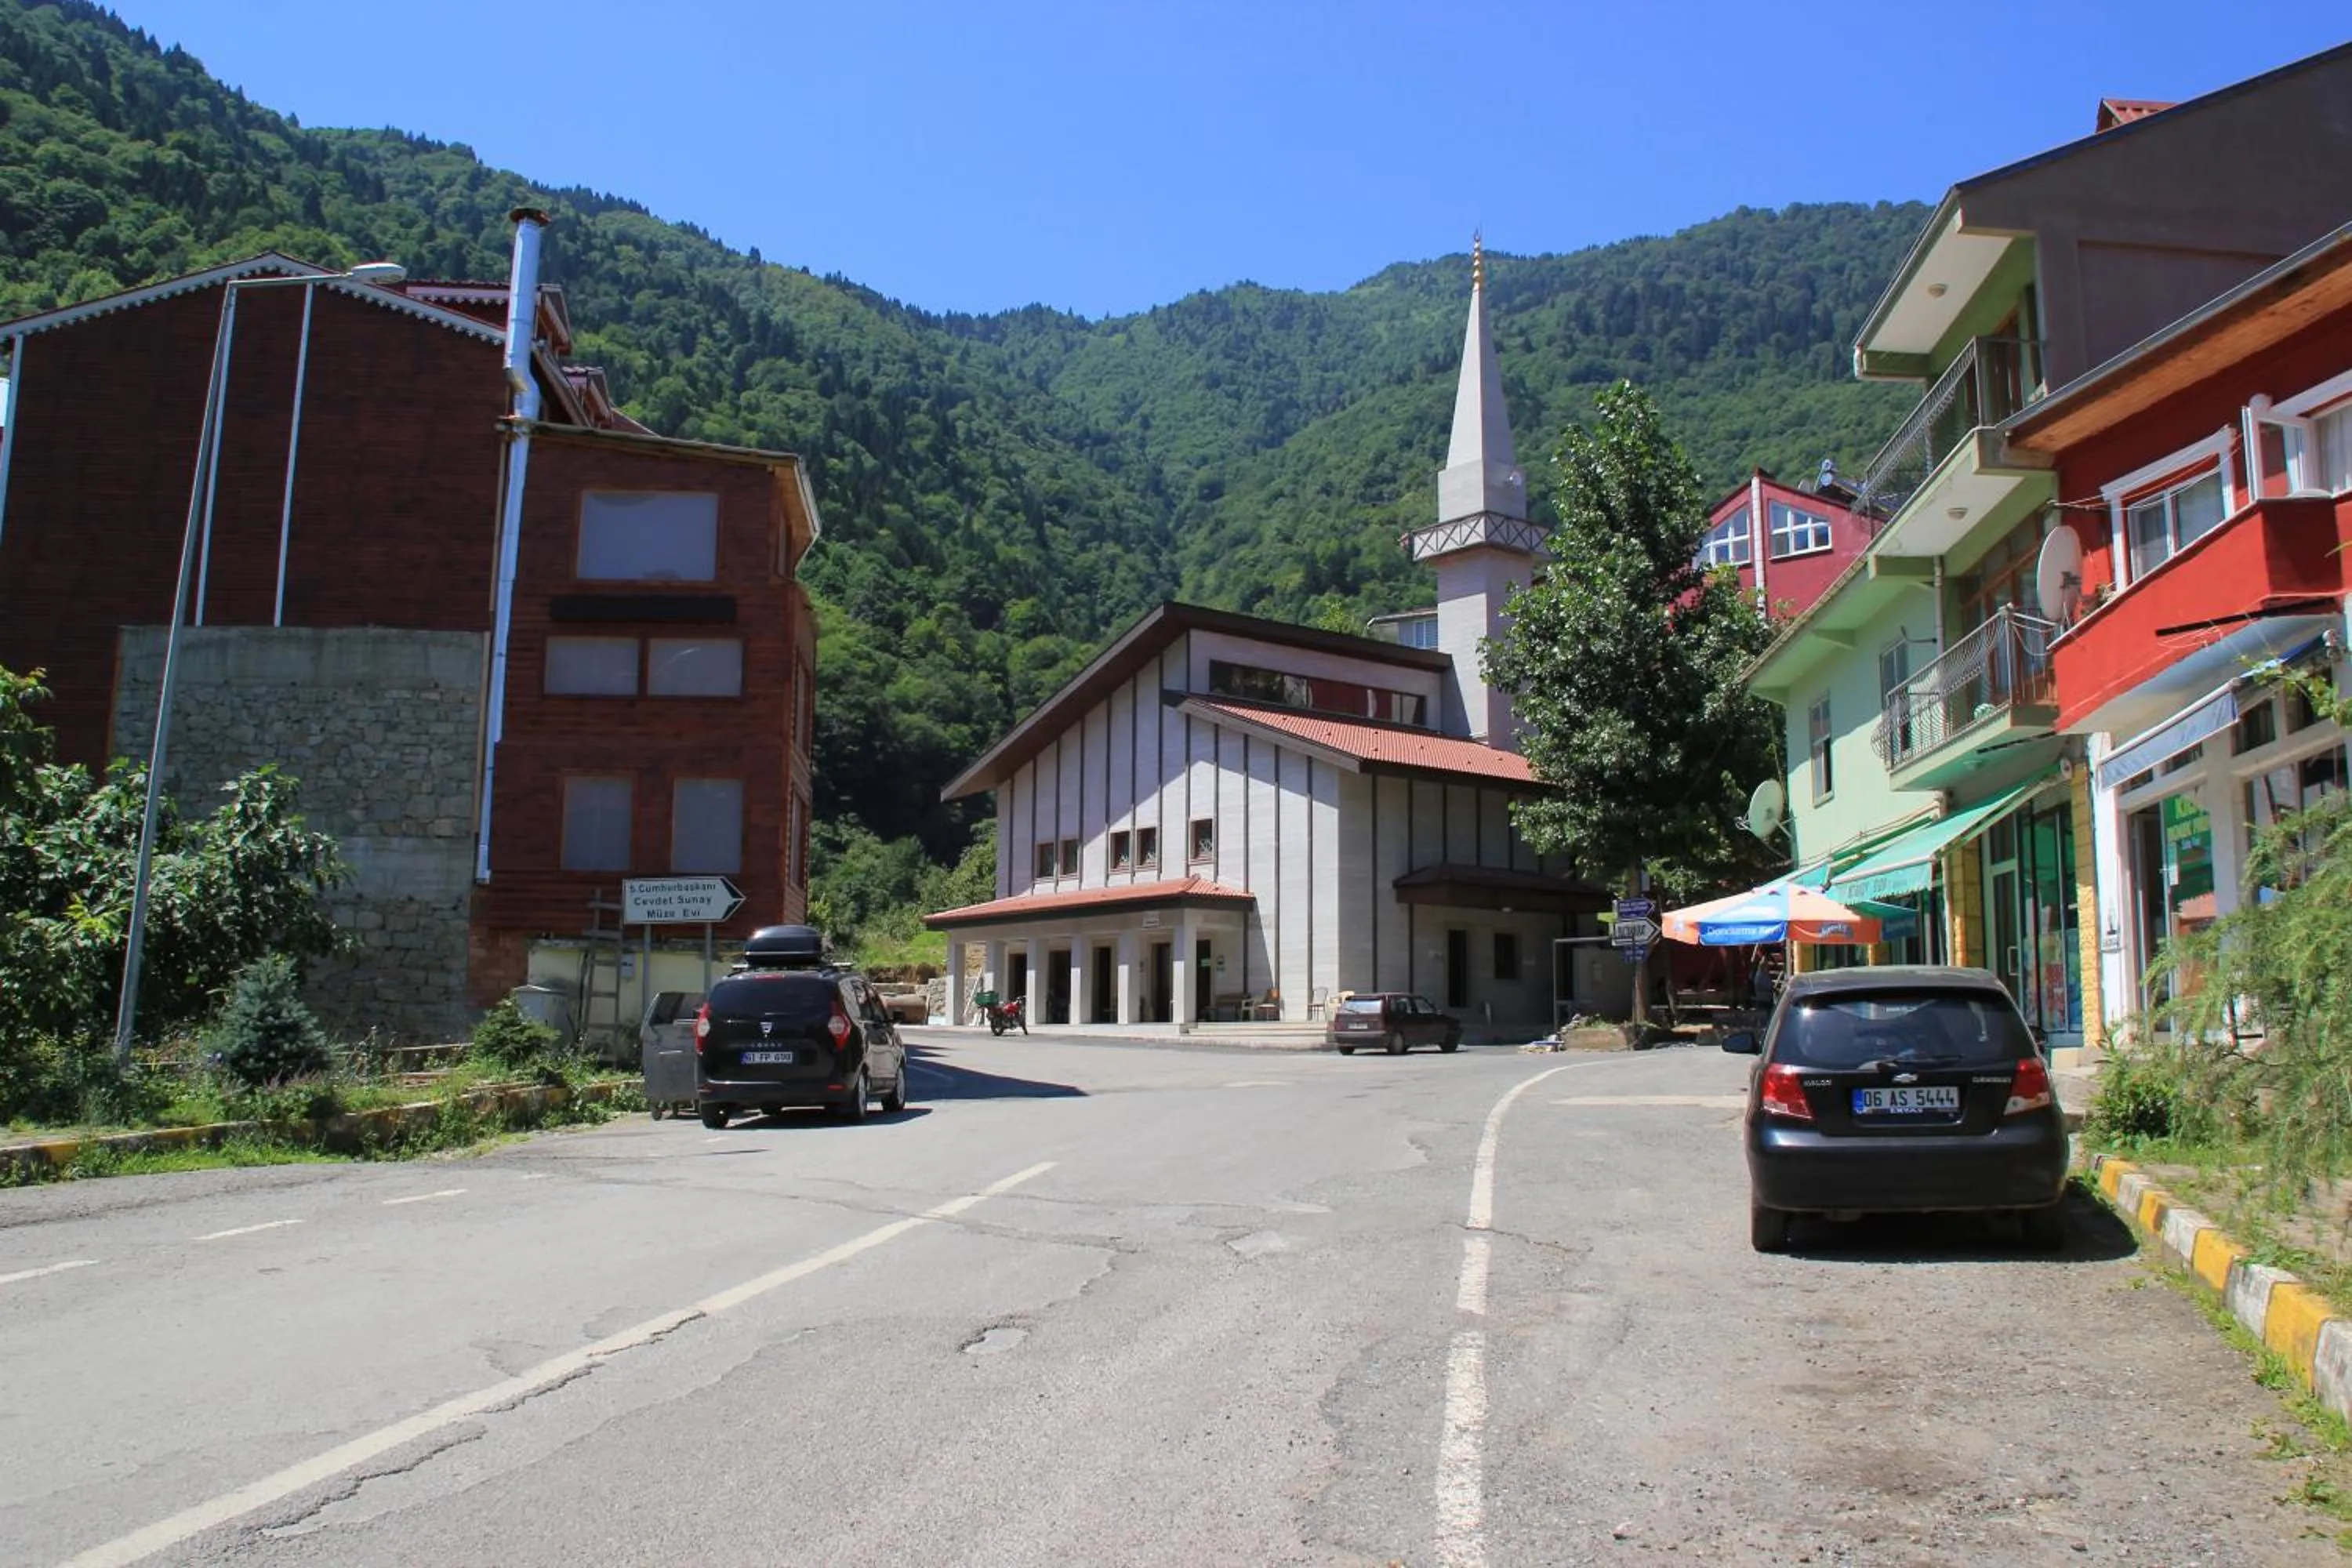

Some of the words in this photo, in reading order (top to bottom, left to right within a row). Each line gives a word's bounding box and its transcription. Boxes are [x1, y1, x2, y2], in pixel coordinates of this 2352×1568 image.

[634, 897, 673, 906] Cevdet
[677, 895, 713, 905] Sunay
[647, 909, 675, 918] Müze
[684, 908, 700, 917] Evi
[1864, 1091, 1882, 1107] 06
[1890, 1091, 1907, 1106] AS
[1915, 1089, 1955, 1106] 5444
